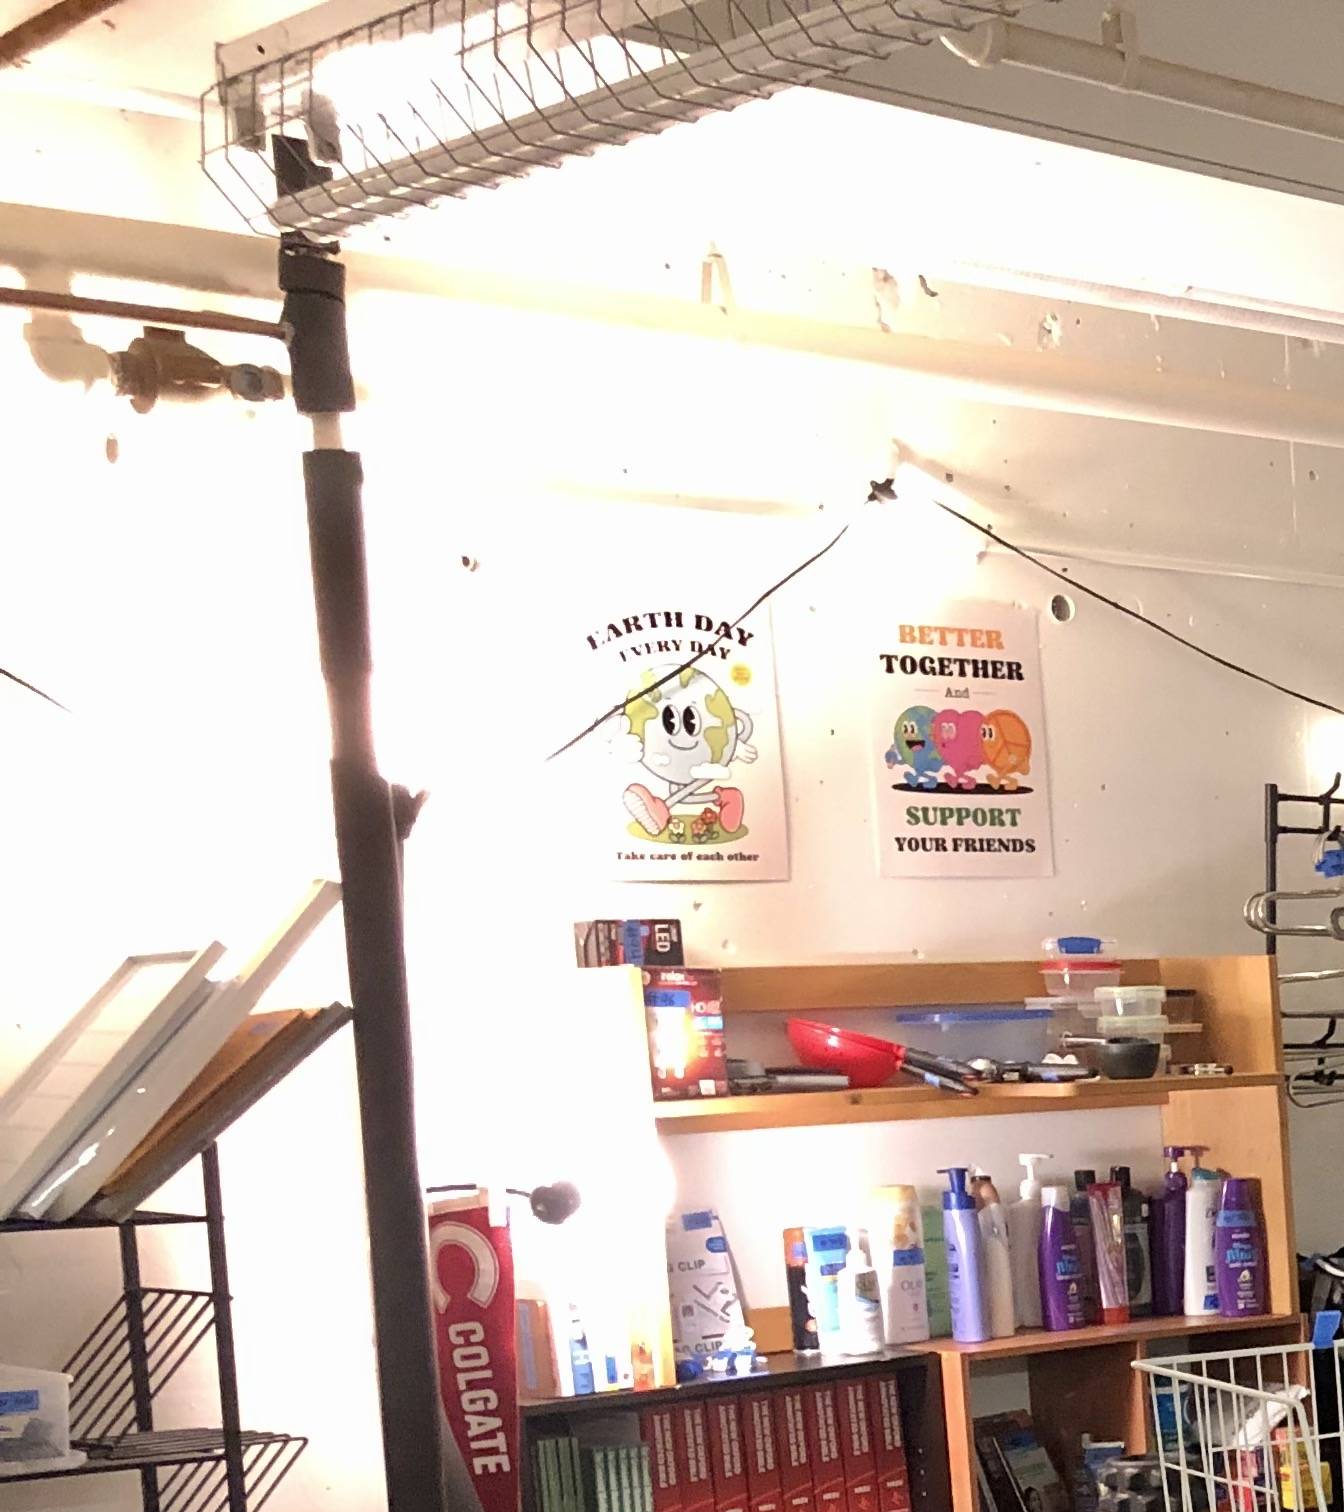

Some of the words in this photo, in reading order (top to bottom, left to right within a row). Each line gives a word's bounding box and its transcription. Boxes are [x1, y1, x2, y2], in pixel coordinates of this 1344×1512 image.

[694, 614, 754, 647] DAY
[898, 624, 1005, 650] BETTER
[690, 640, 731, 660] DAY
[879, 653, 1025, 681] TOGETHER
[944, 687, 970, 699] And
[906, 806, 1022, 827] SUPPORT
[894, 836, 949, 853] YOUR
[951, 838, 1036, 854] FRIENDS
[617, 852, 646, 861] Take
[649, 853, 677, 861] care
[680, 851, 694, 861] of
[695, 852, 724, 862] each
[726, 852, 760, 862] other
[654, 923, 671, 953] LED
[677, 1258, 706, 1273] CLIP
[448, 1320, 511, 1476] COLGATE
